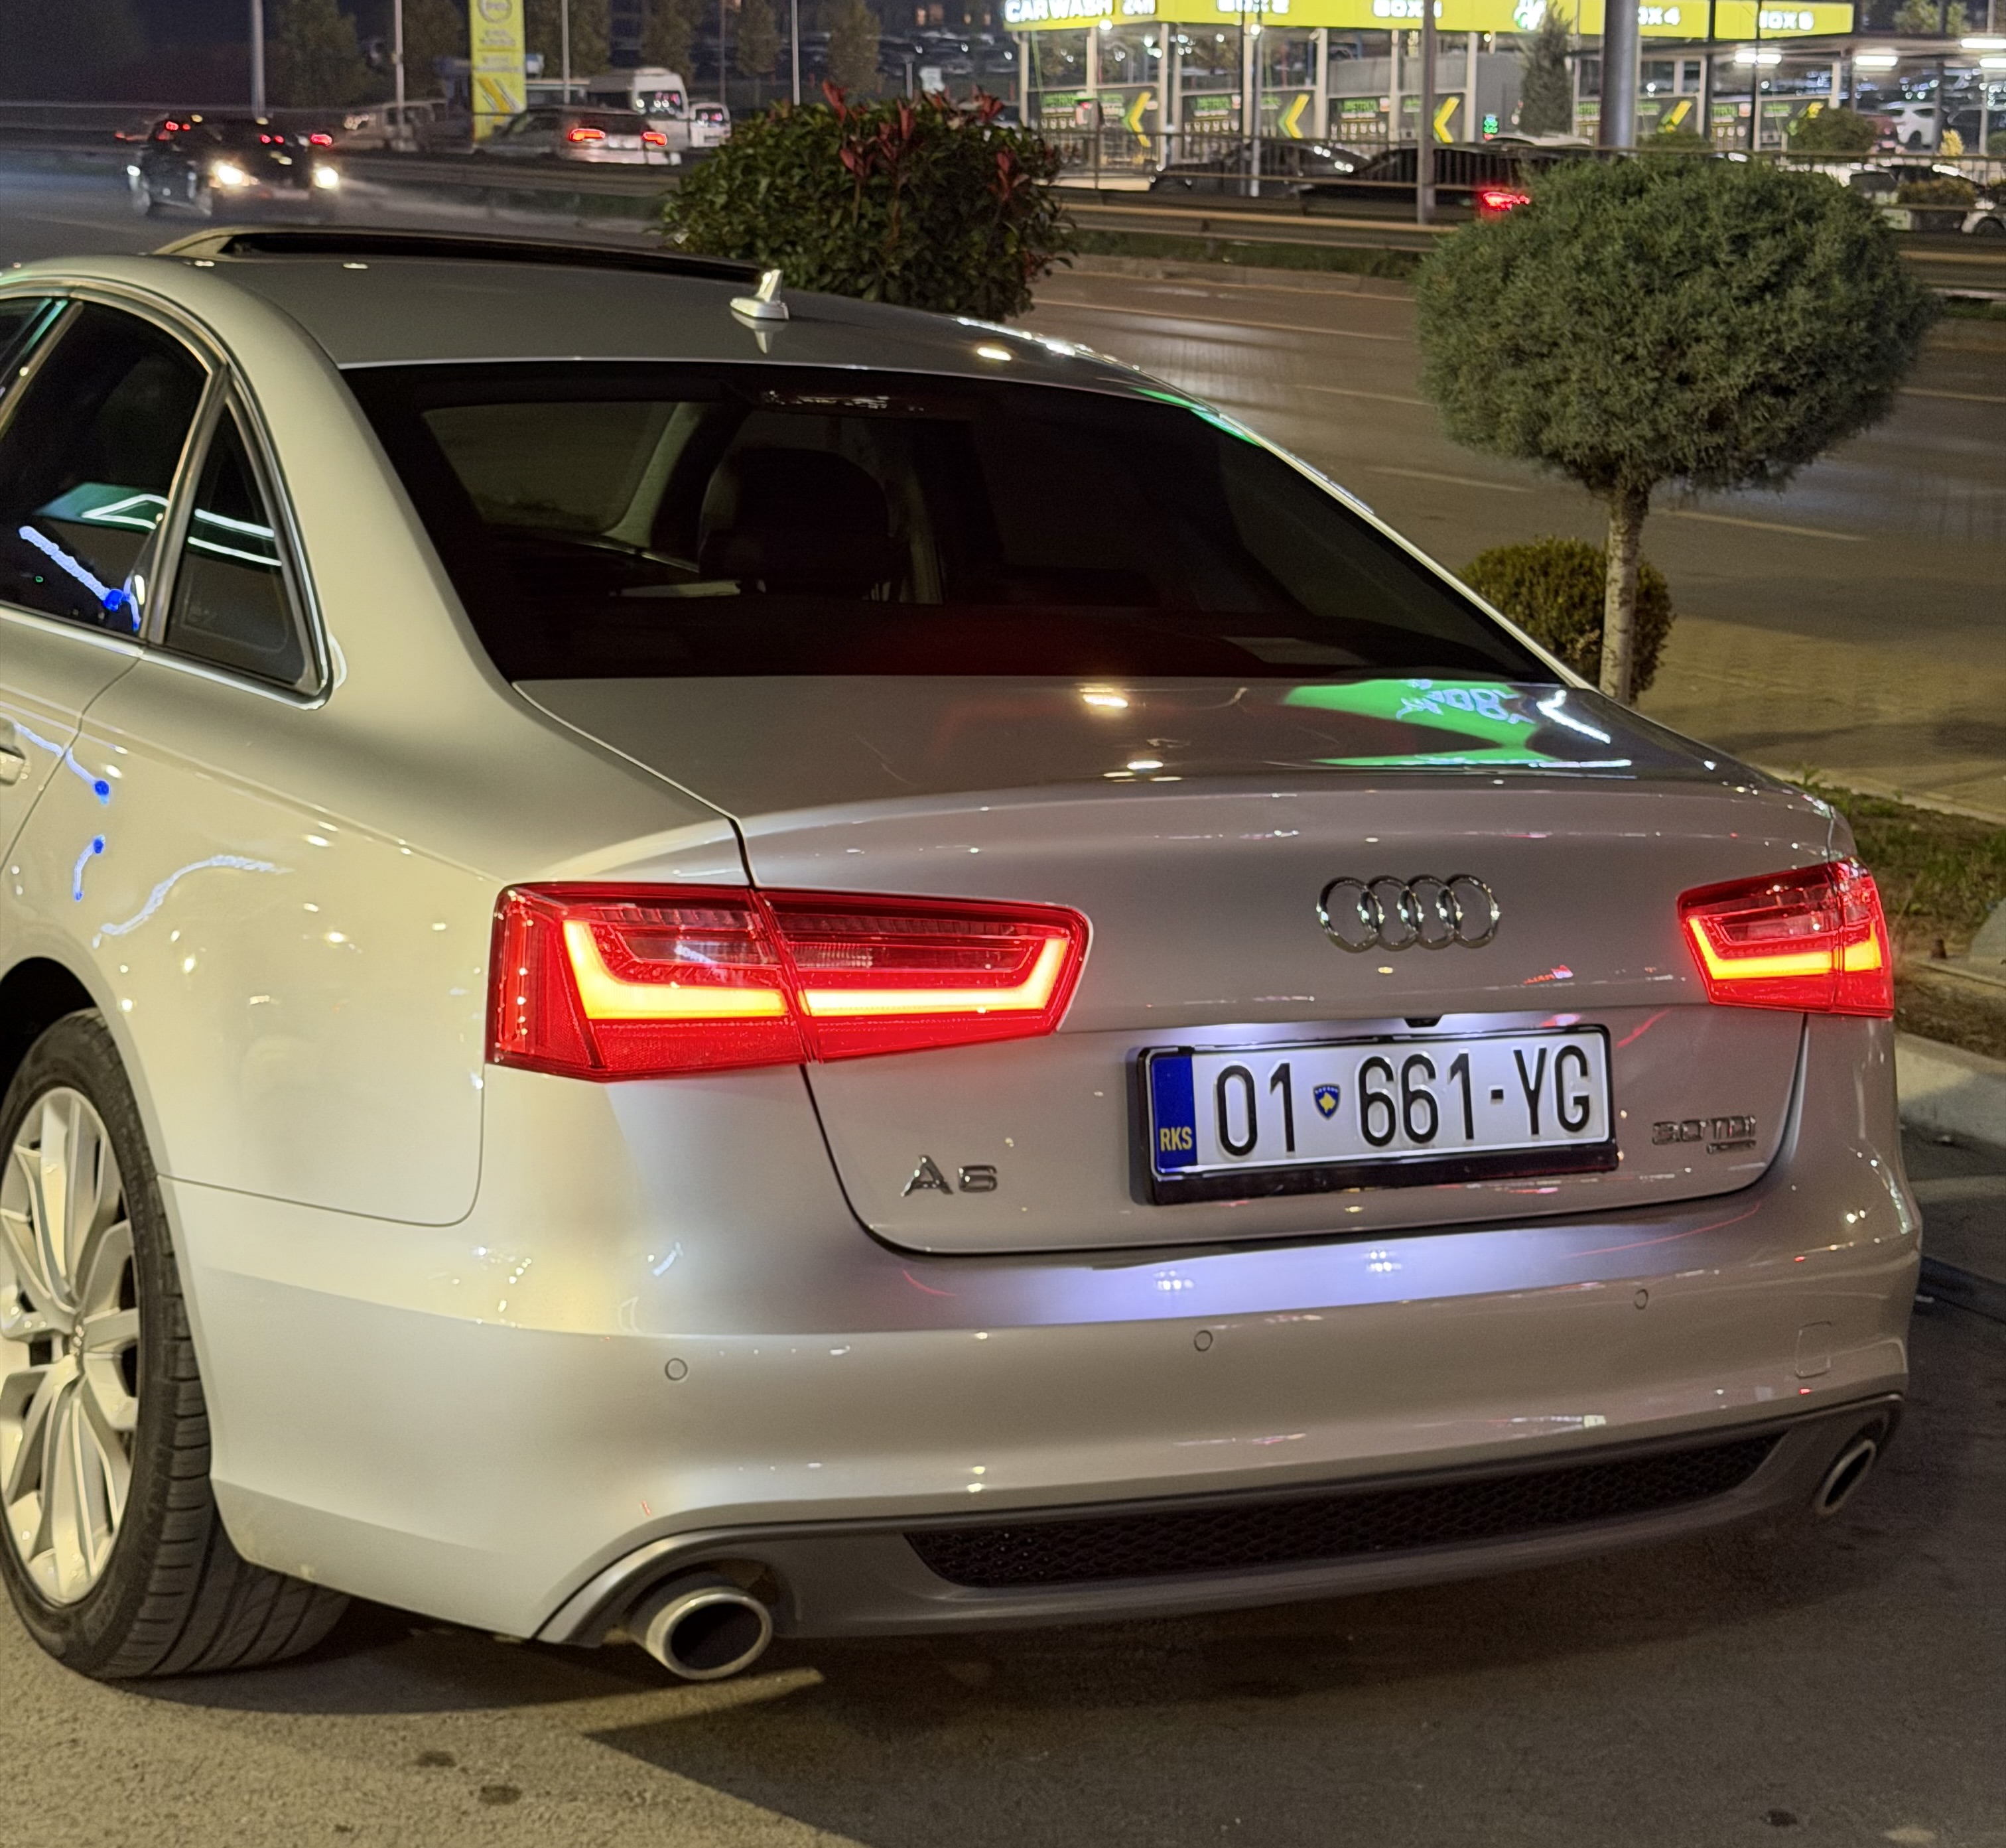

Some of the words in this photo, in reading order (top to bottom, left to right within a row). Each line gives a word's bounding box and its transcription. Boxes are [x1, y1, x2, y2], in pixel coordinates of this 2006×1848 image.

[1216, 1062, 1296, 1157] 01
[1357, 1043, 1591, 1147] 661-YG
[1160, 1126, 1193, 1152] RKS
[900, 1154, 998, 1197] A6
